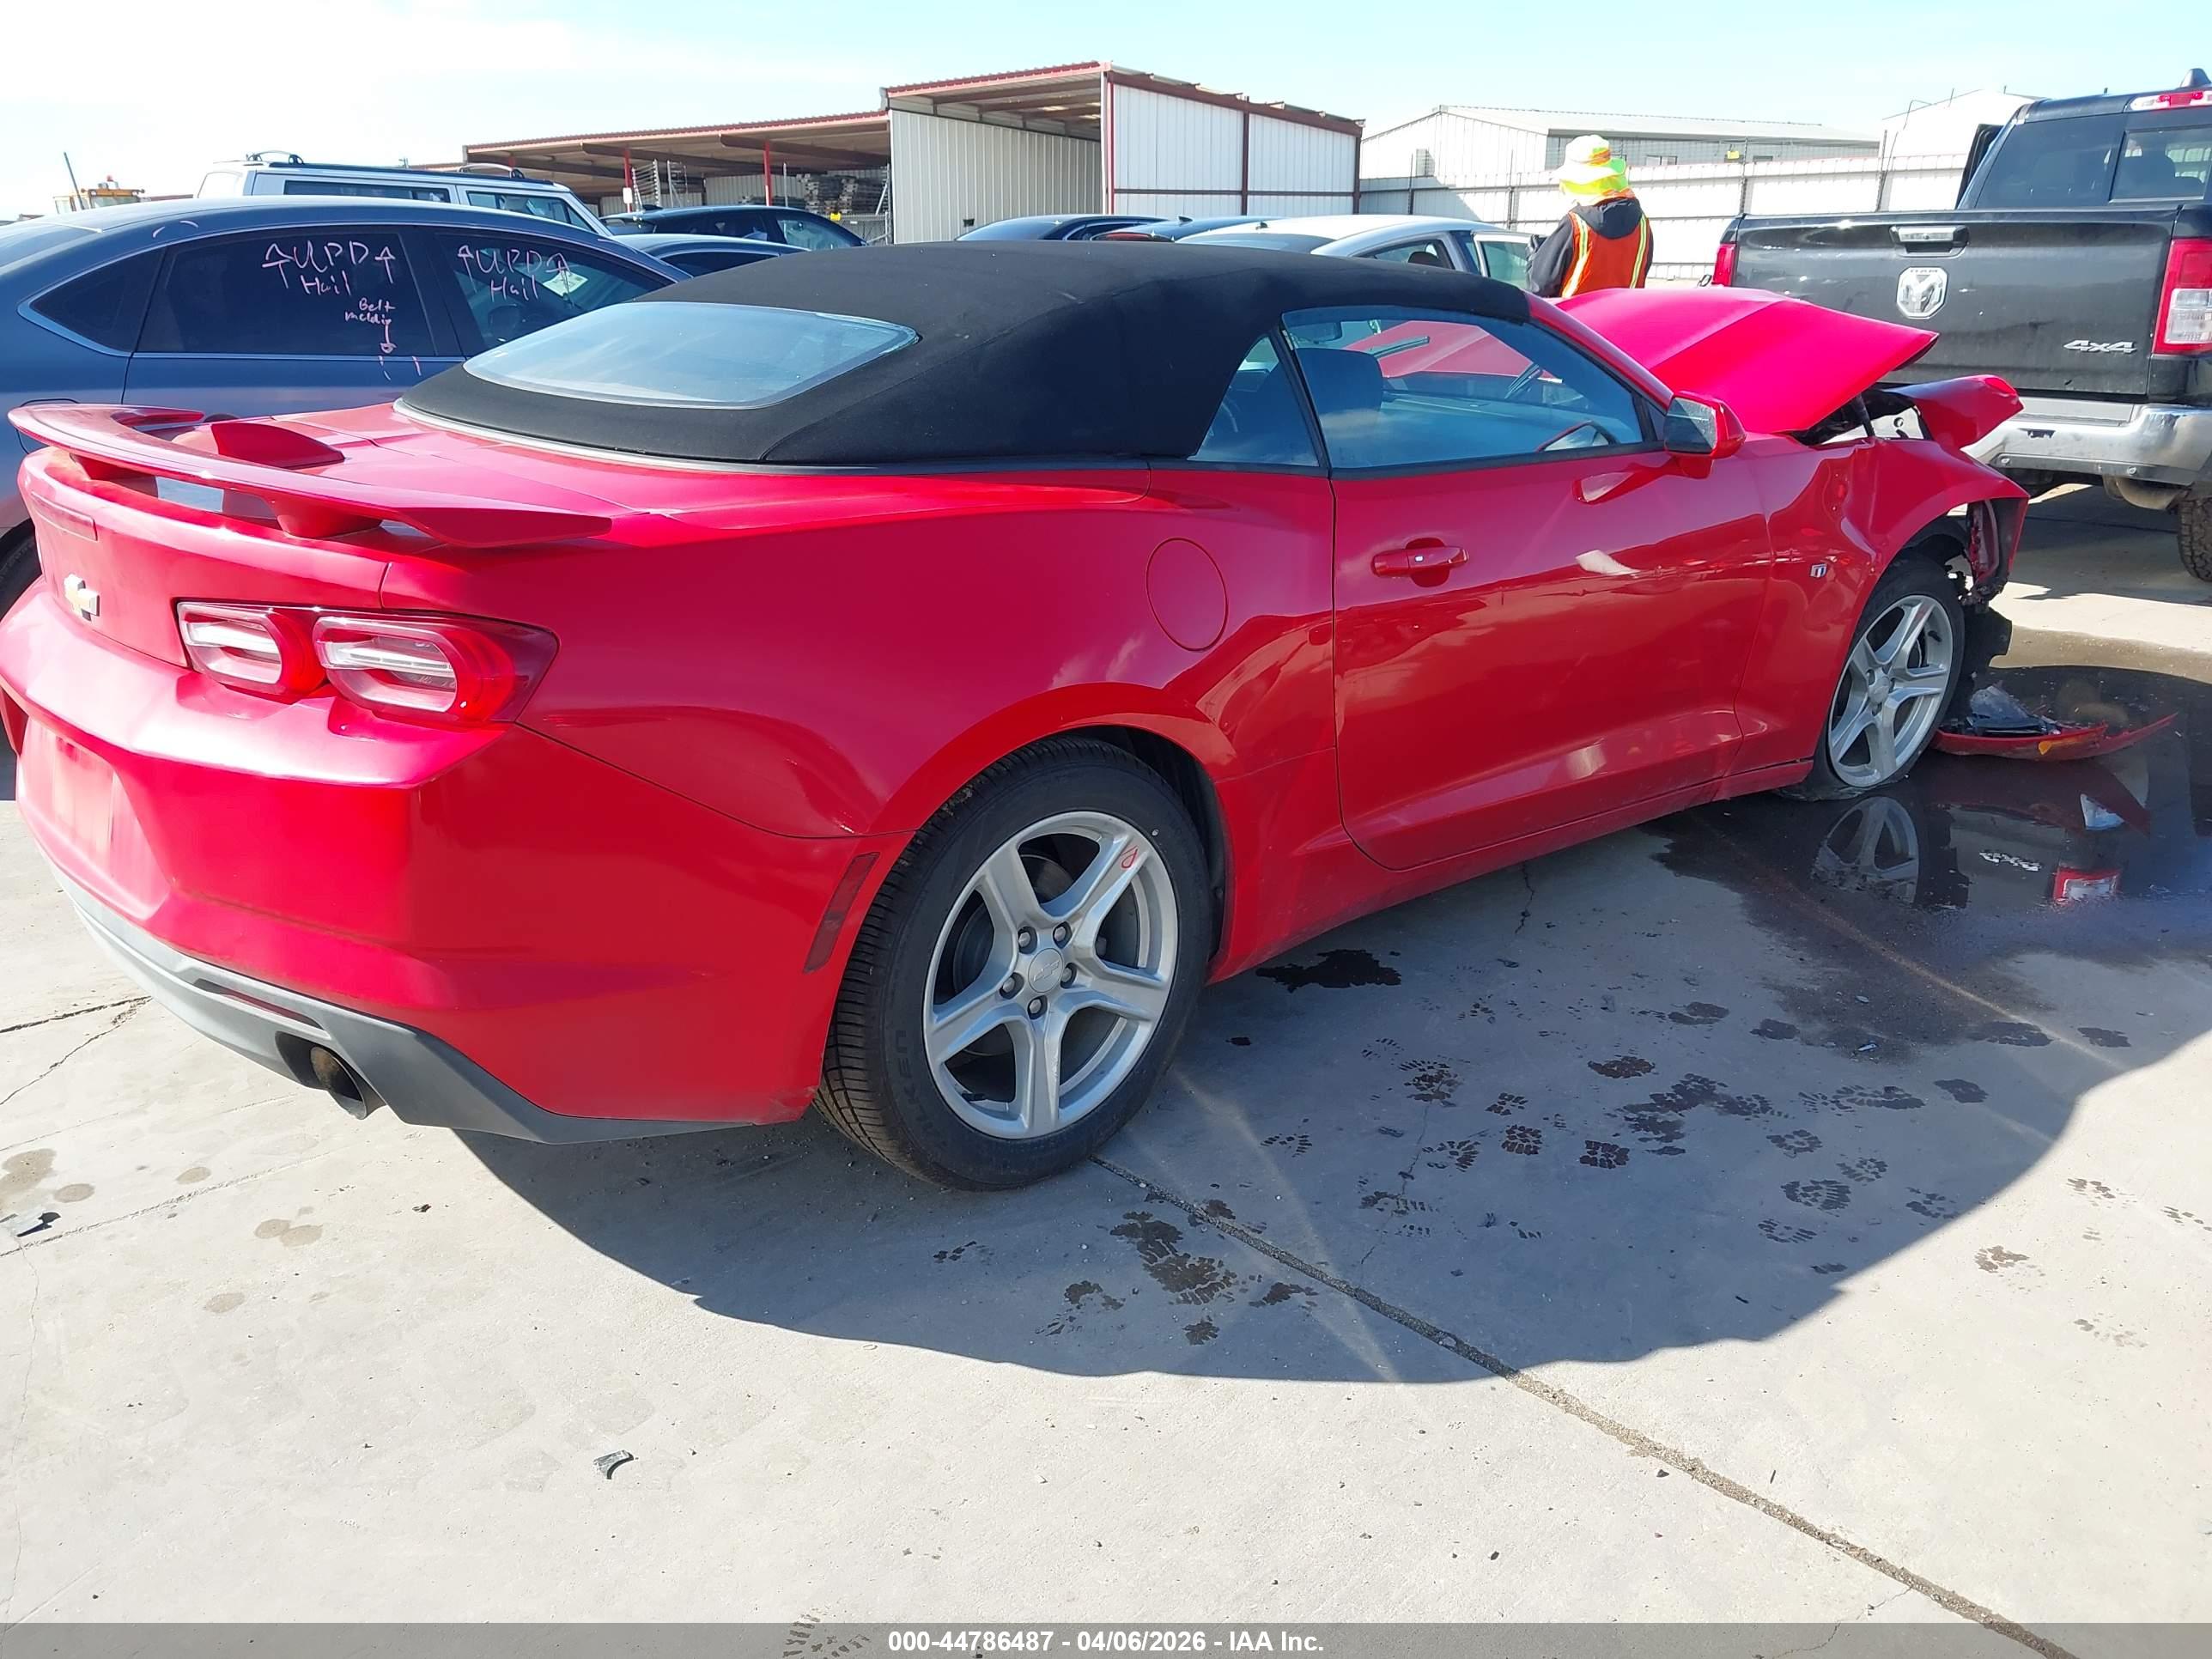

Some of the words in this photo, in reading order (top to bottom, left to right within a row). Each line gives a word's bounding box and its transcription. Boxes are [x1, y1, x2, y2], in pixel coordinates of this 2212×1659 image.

[301, 270, 351, 295] Hail
[490, 274, 538, 302] Hail
[359, 297, 396, 313] Belt
[2063, 339, 2137, 354] 4x4
